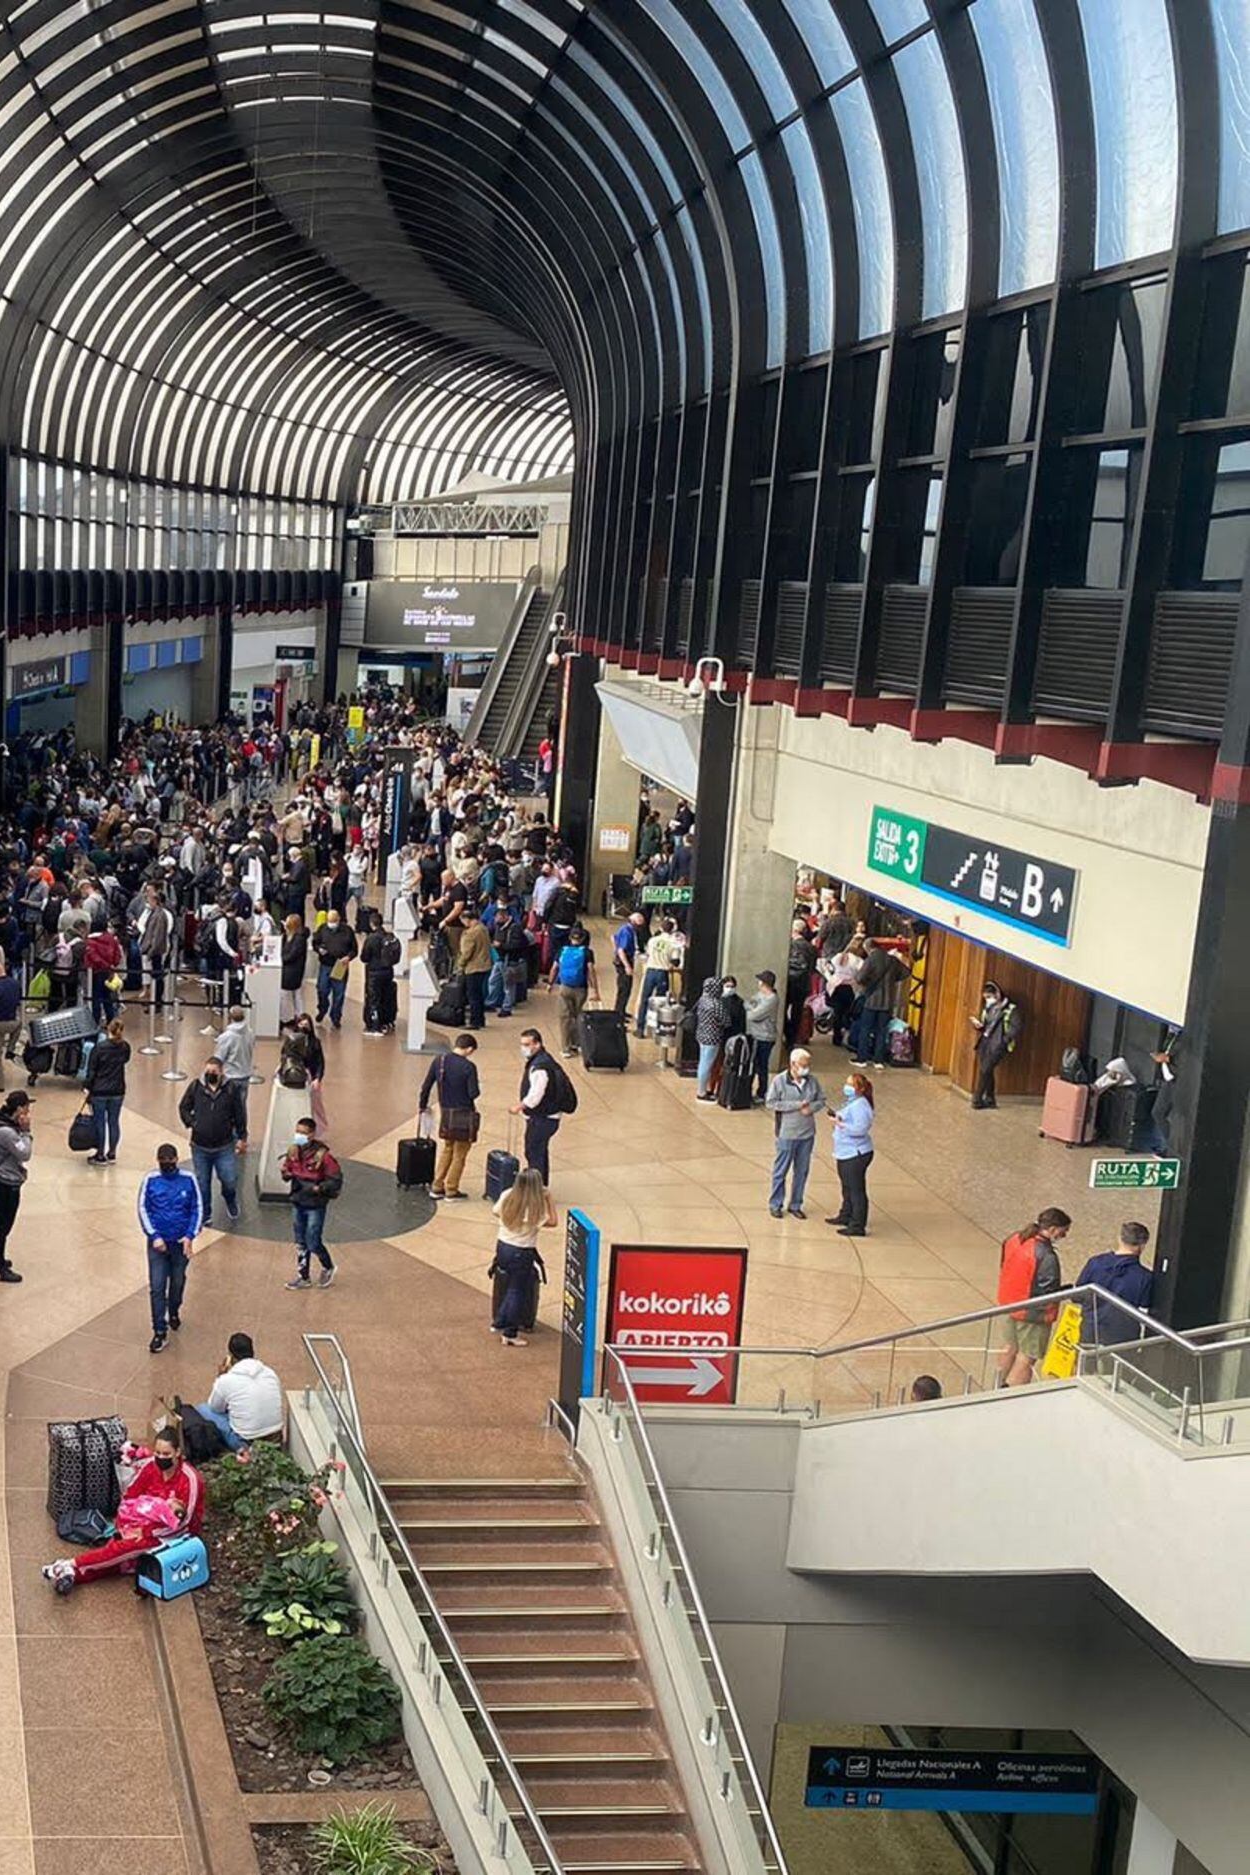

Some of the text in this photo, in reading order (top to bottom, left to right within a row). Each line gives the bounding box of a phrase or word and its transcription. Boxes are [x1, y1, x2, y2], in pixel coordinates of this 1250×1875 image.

[904, 829, 920, 875] 3
[1020, 863, 1044, 918] B
[1097, 1163, 1140, 1174] RUTA
[876, 1758, 981, 1771] Llegadas Nacionales A
[997, 1761, 1036, 1772] Oficinas
